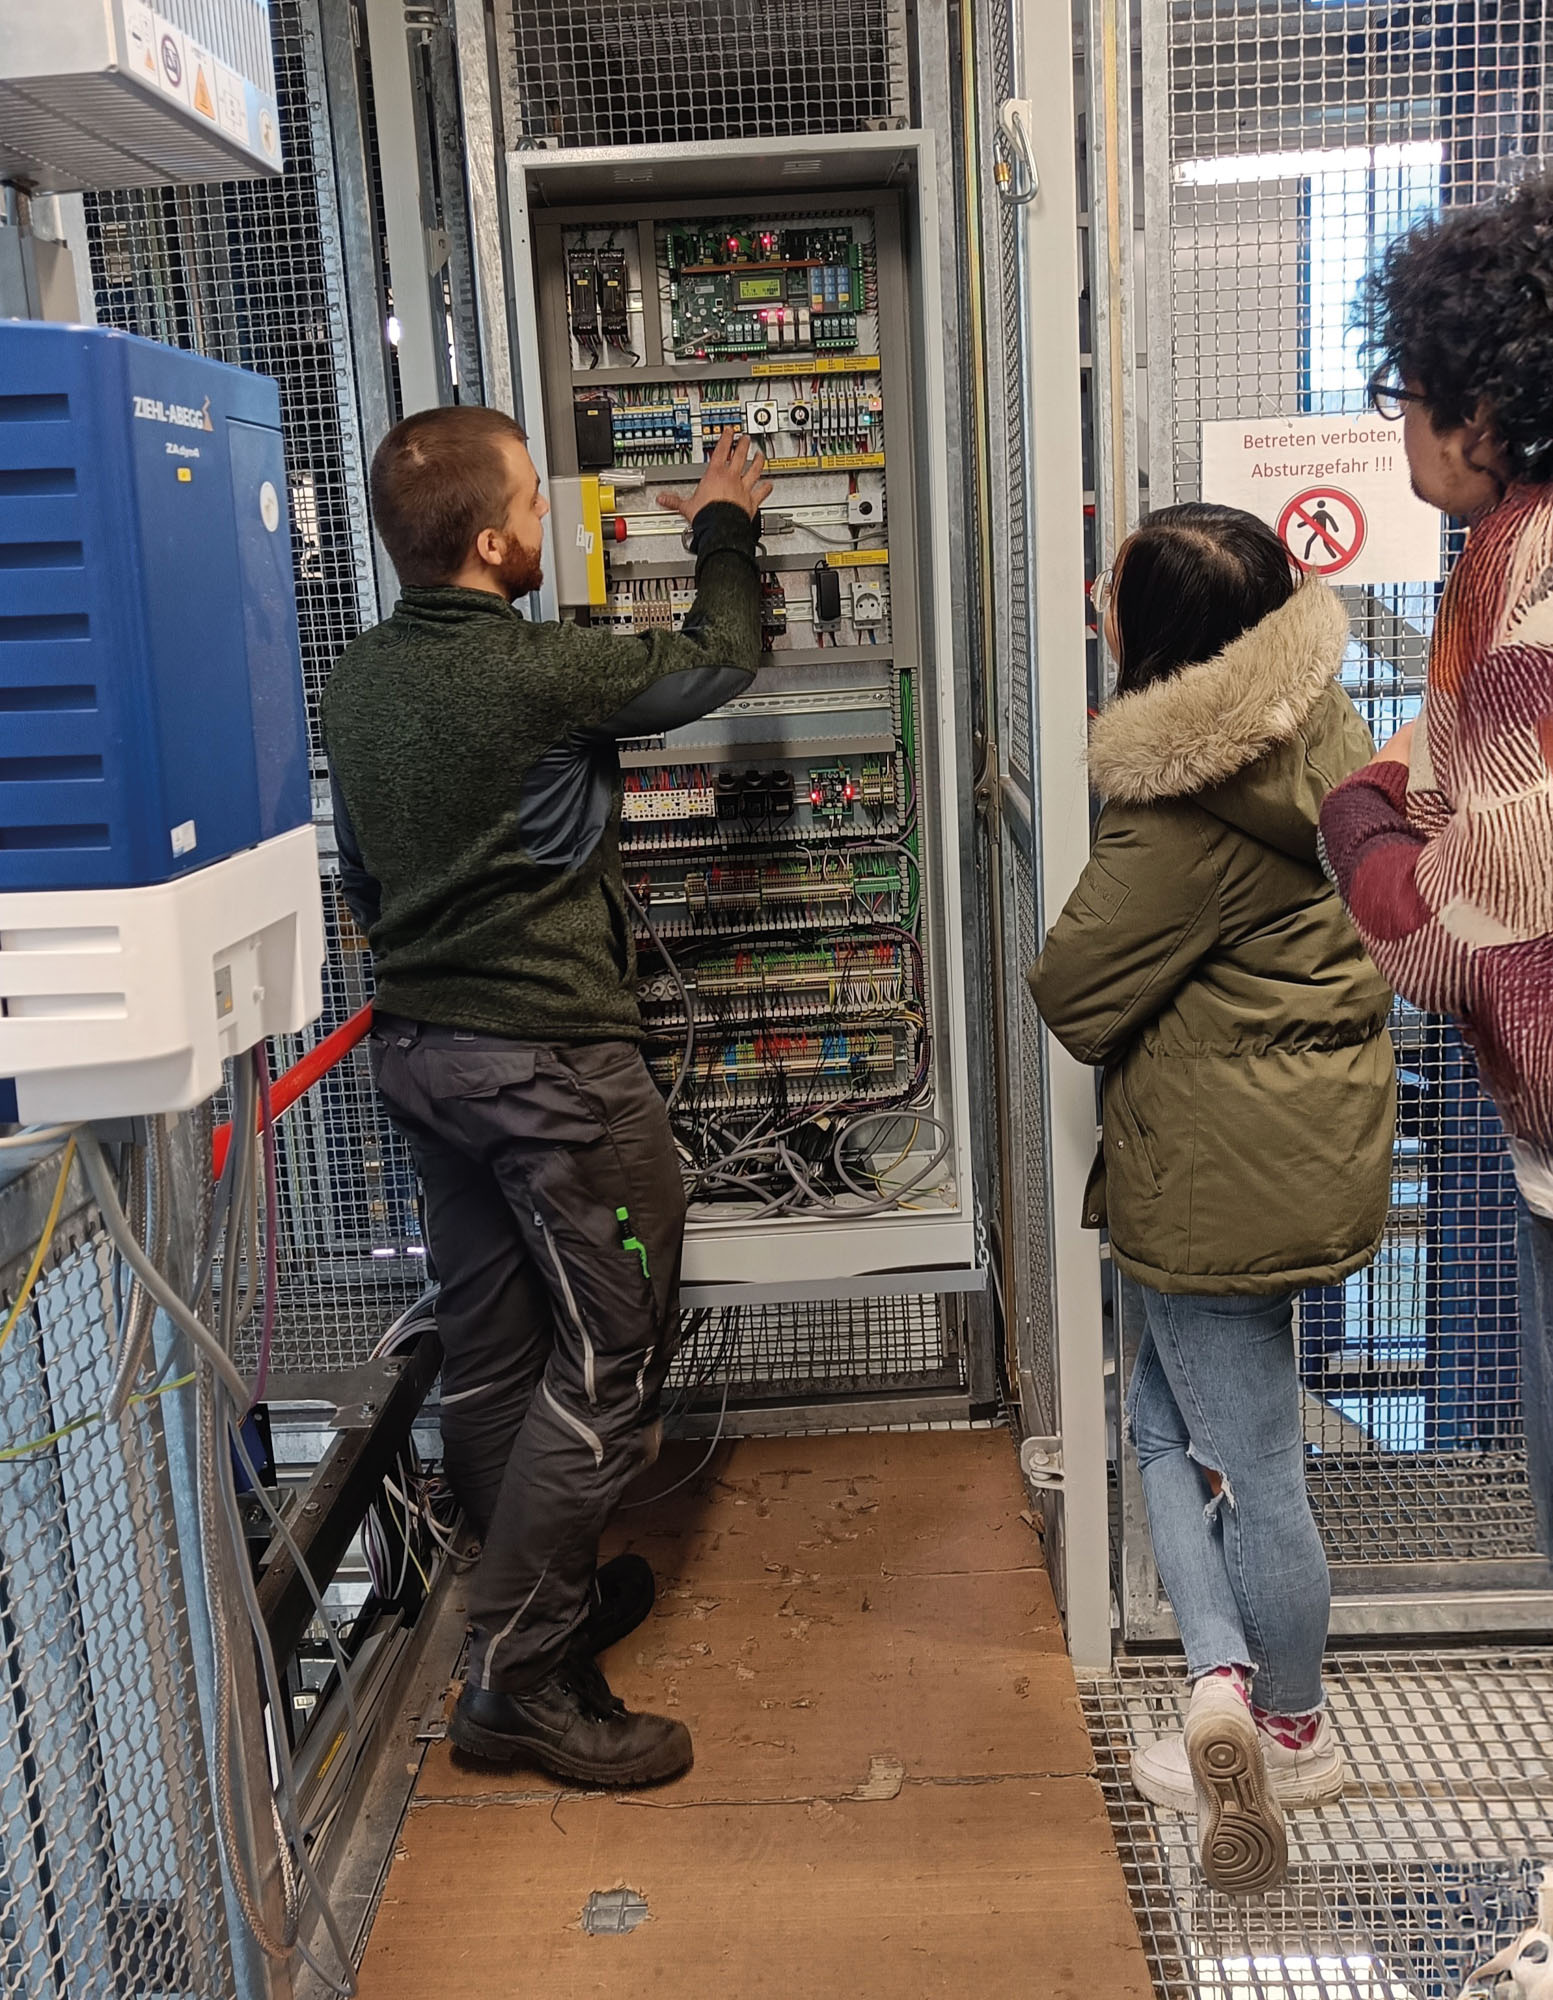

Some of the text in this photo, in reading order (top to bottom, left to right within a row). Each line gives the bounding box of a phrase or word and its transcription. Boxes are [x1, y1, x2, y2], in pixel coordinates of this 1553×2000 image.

[133, 396, 204, 429] ZIEHL-ABEGG
[1243, 428, 1402, 449] Betreten verboten,
[1251, 456, 1393, 478] Absturzgefahr !!!
